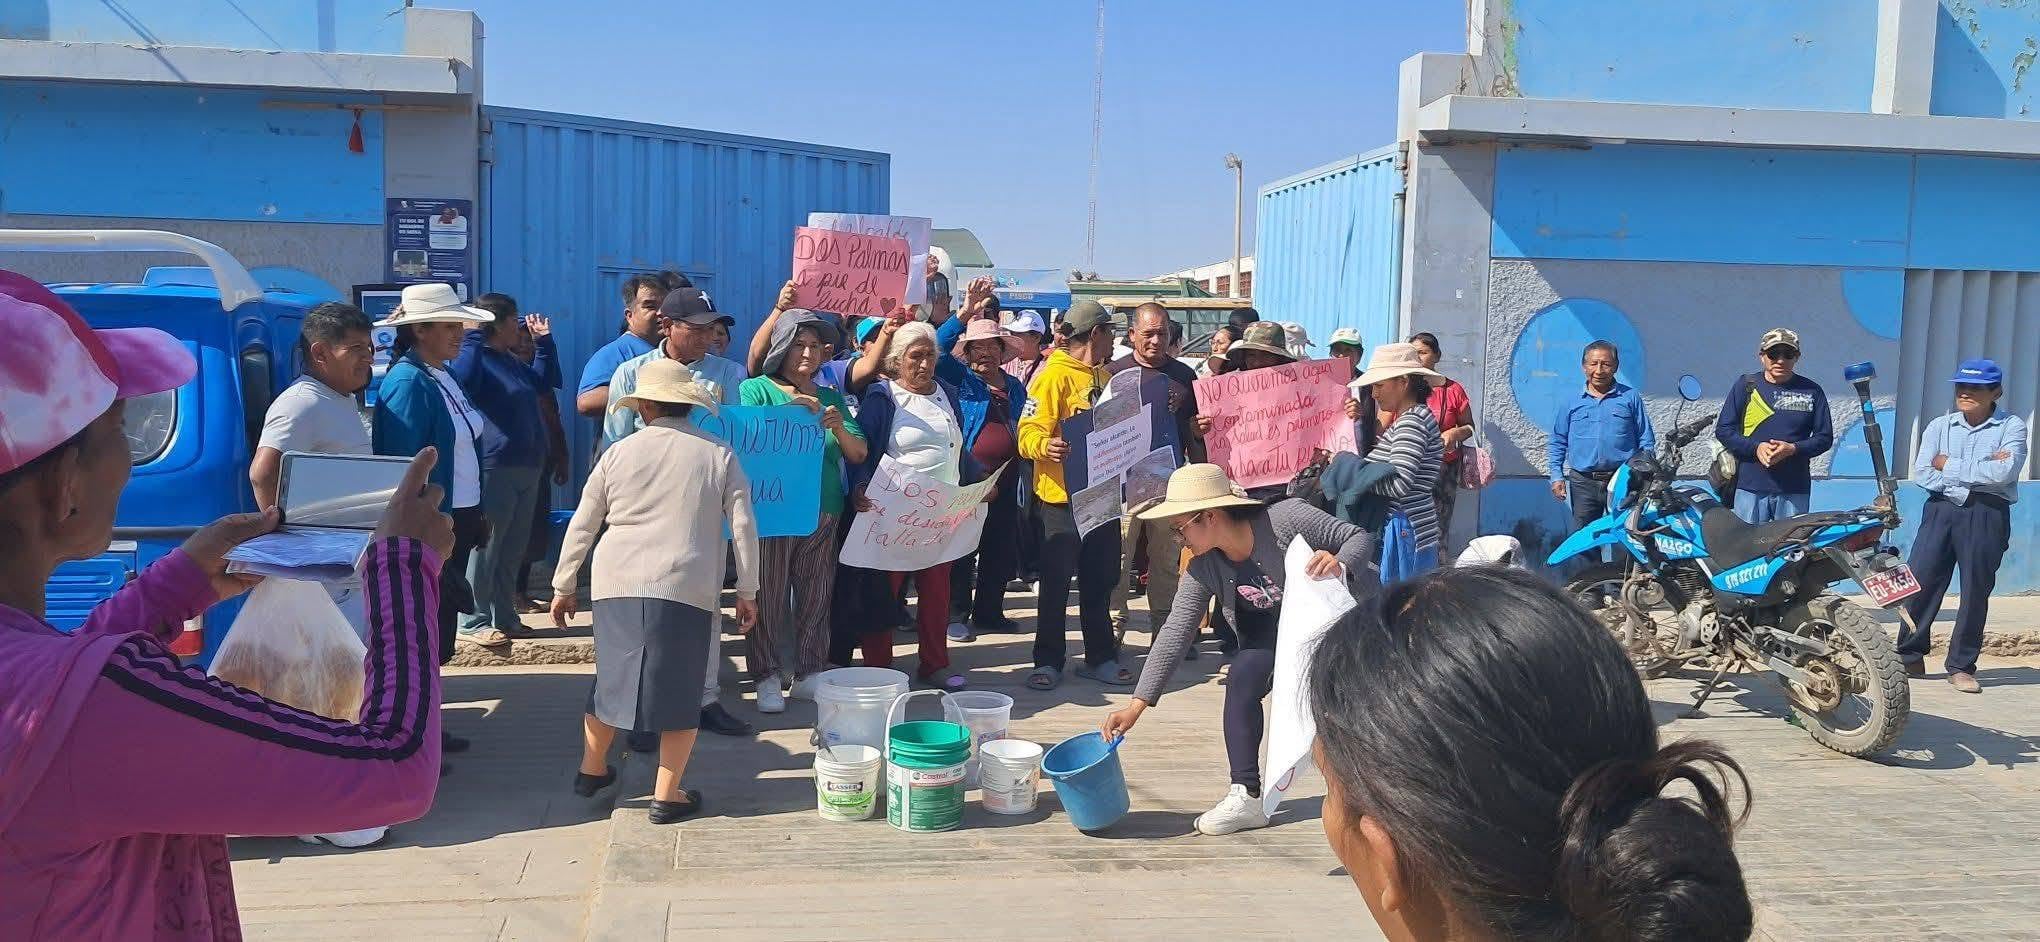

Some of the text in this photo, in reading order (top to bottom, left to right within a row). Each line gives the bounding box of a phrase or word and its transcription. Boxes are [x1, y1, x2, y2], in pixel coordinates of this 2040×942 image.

[845, 235, 910, 276] Palmas
[816, 271, 850, 297] pie
[854, 271, 879, 297] de
[810, 292, 872, 316] lucha
[1200, 378, 1222, 406] NO
[1302, 362, 1333, 384] agua
[880, 467, 940, 508] DOS
[922, 772, 948, 780] Castrol
